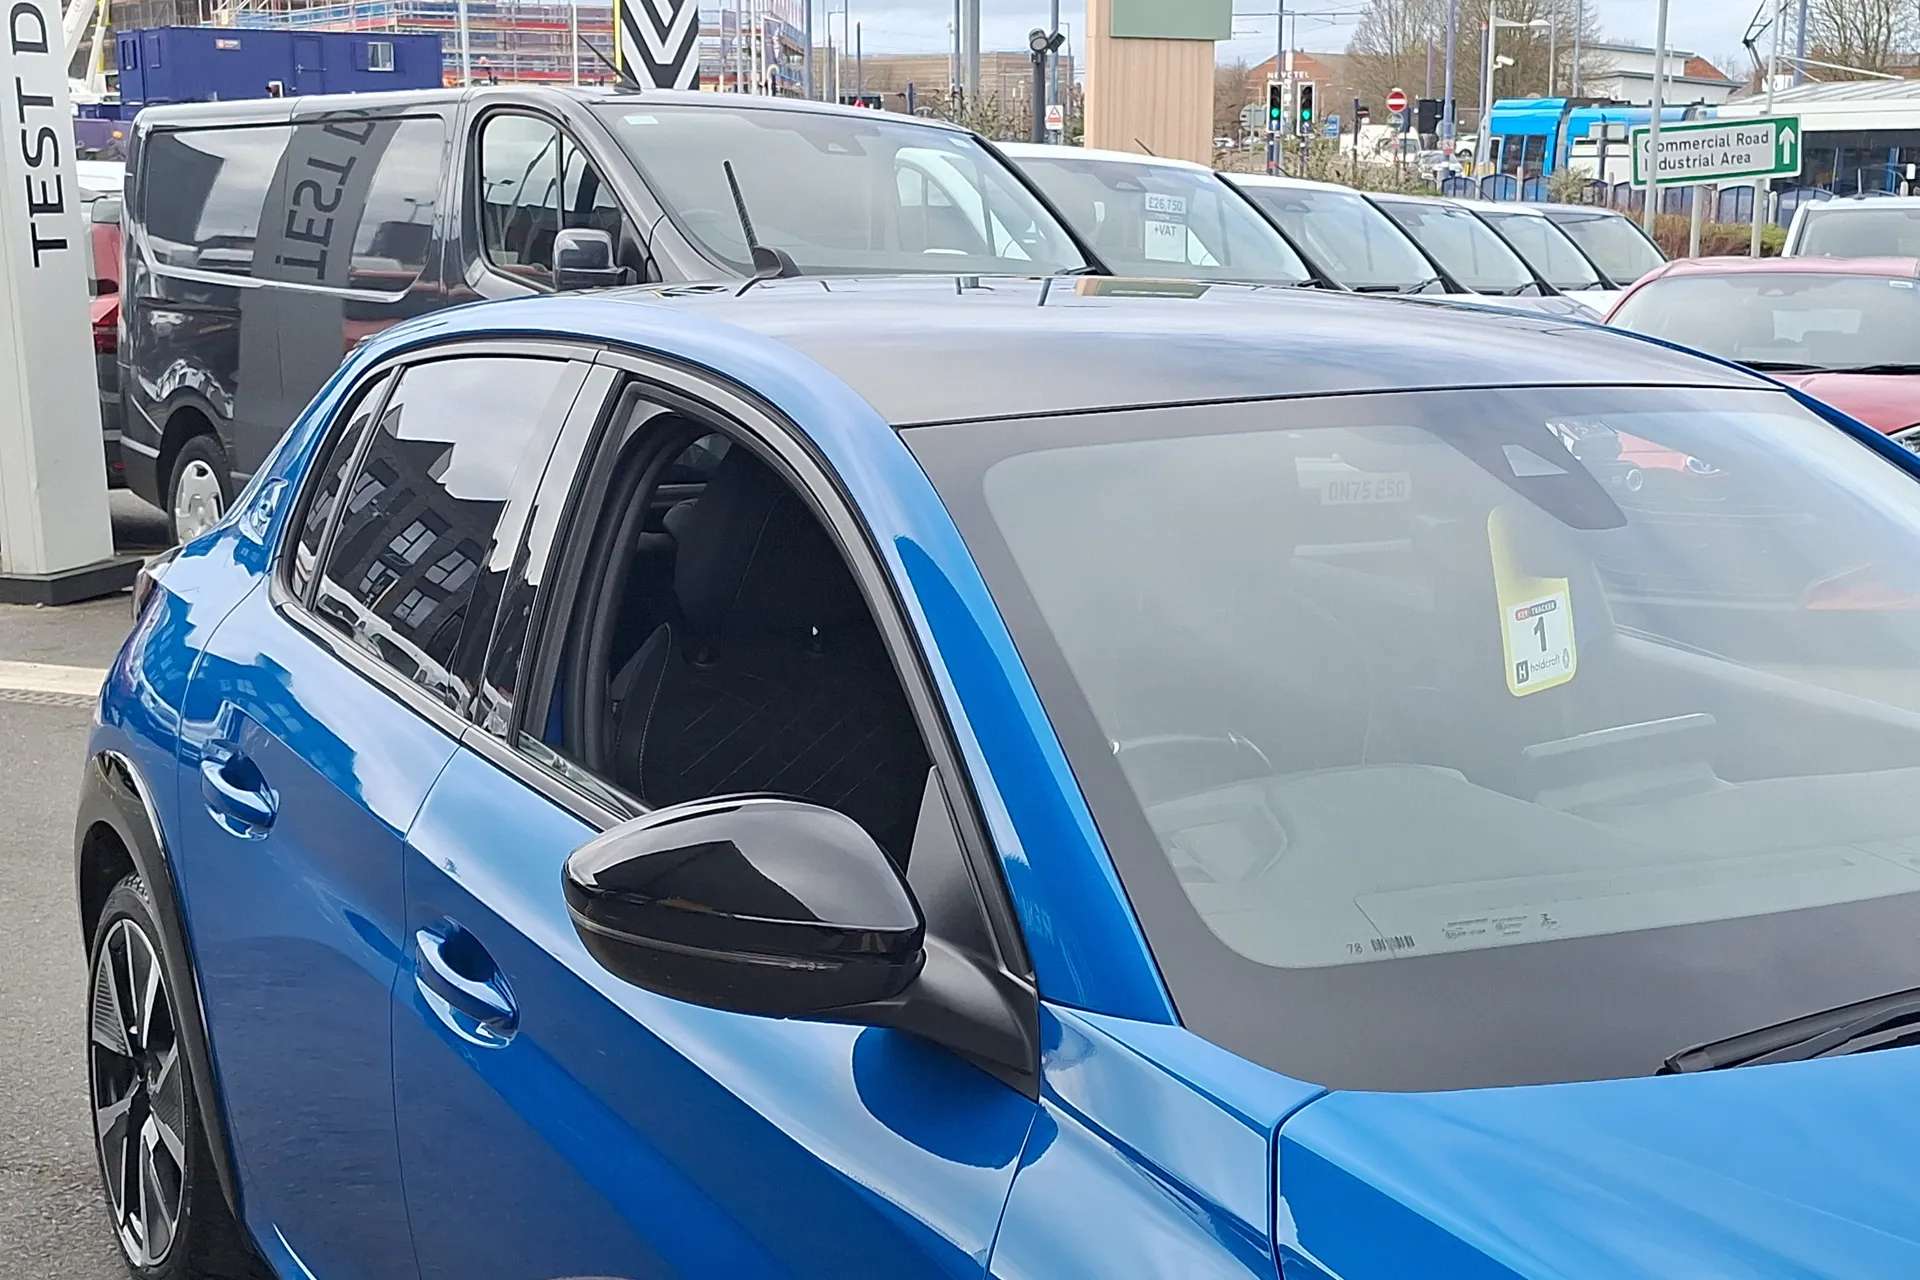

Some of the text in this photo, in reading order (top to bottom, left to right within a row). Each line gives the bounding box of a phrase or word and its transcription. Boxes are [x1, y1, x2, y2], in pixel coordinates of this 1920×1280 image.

[1736, 131, 1769, 146] Road
[15, 76, 68, 268] TEST
[1643, 151, 1752, 172] Idustrial Area
[1533, 615, 1548, 652] 1
